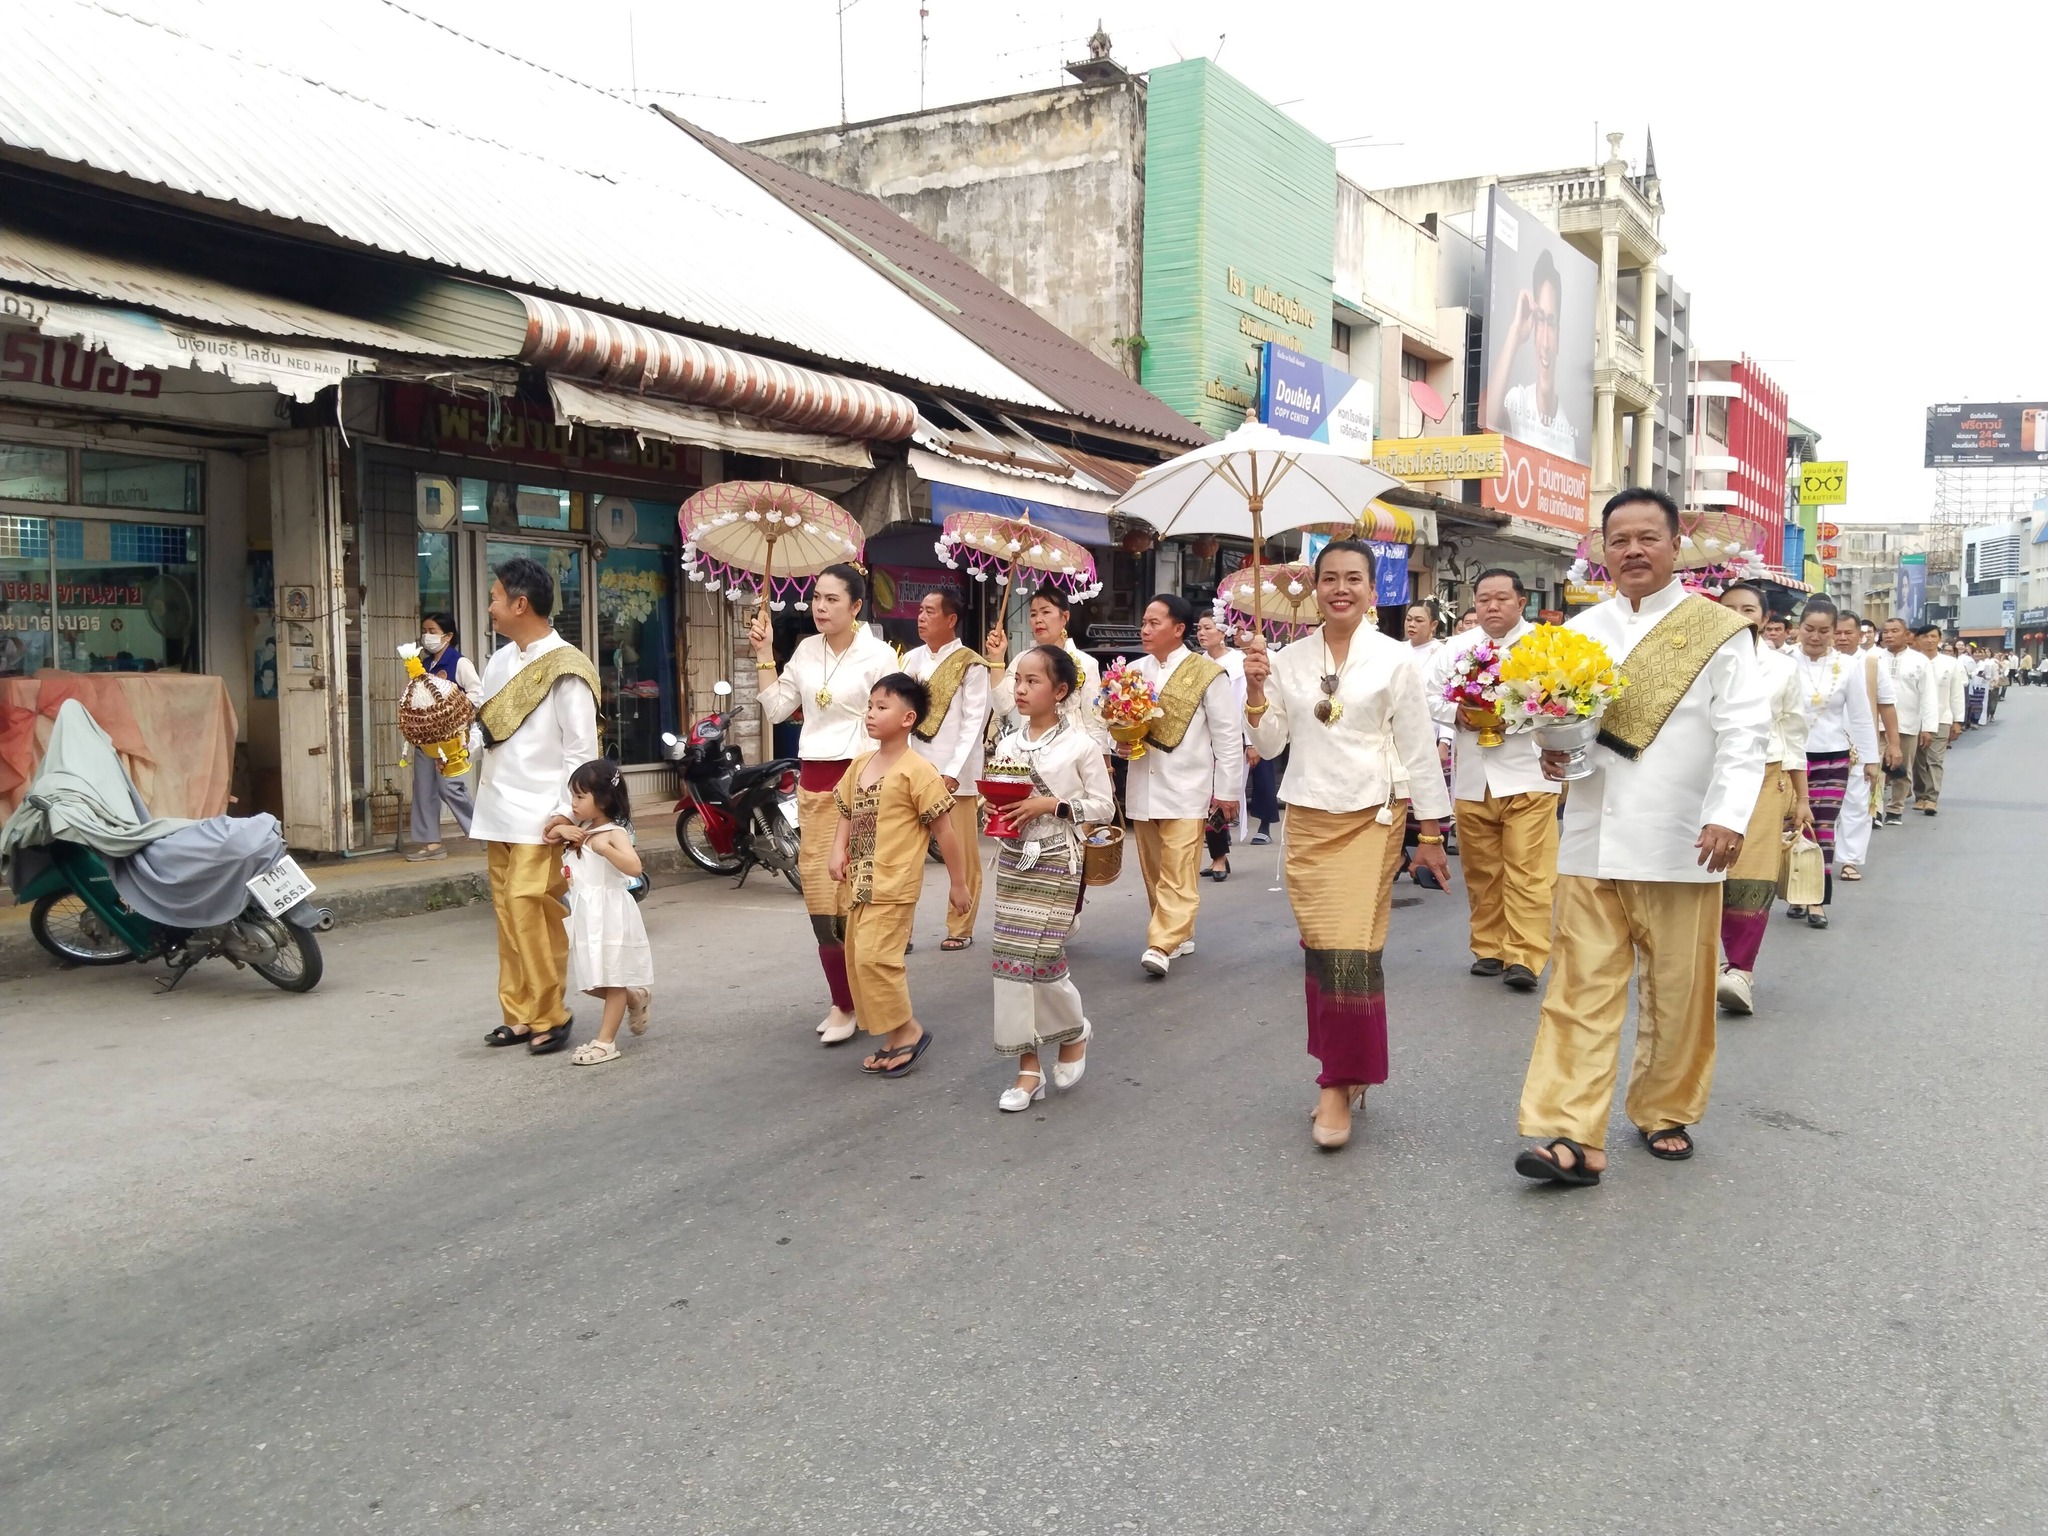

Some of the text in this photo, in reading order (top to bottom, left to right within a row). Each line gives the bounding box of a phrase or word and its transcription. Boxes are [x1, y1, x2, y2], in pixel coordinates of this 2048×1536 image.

[287, 357, 311, 371] NEO
[1275, 379, 1321, 415] Double A
[1274, 406, 1310, 426] COPY CENTER
[1979, 430, 1992, 438] 24
[1978, 440, 1998, 448] 645
[273, 884, 307, 910] 5653
